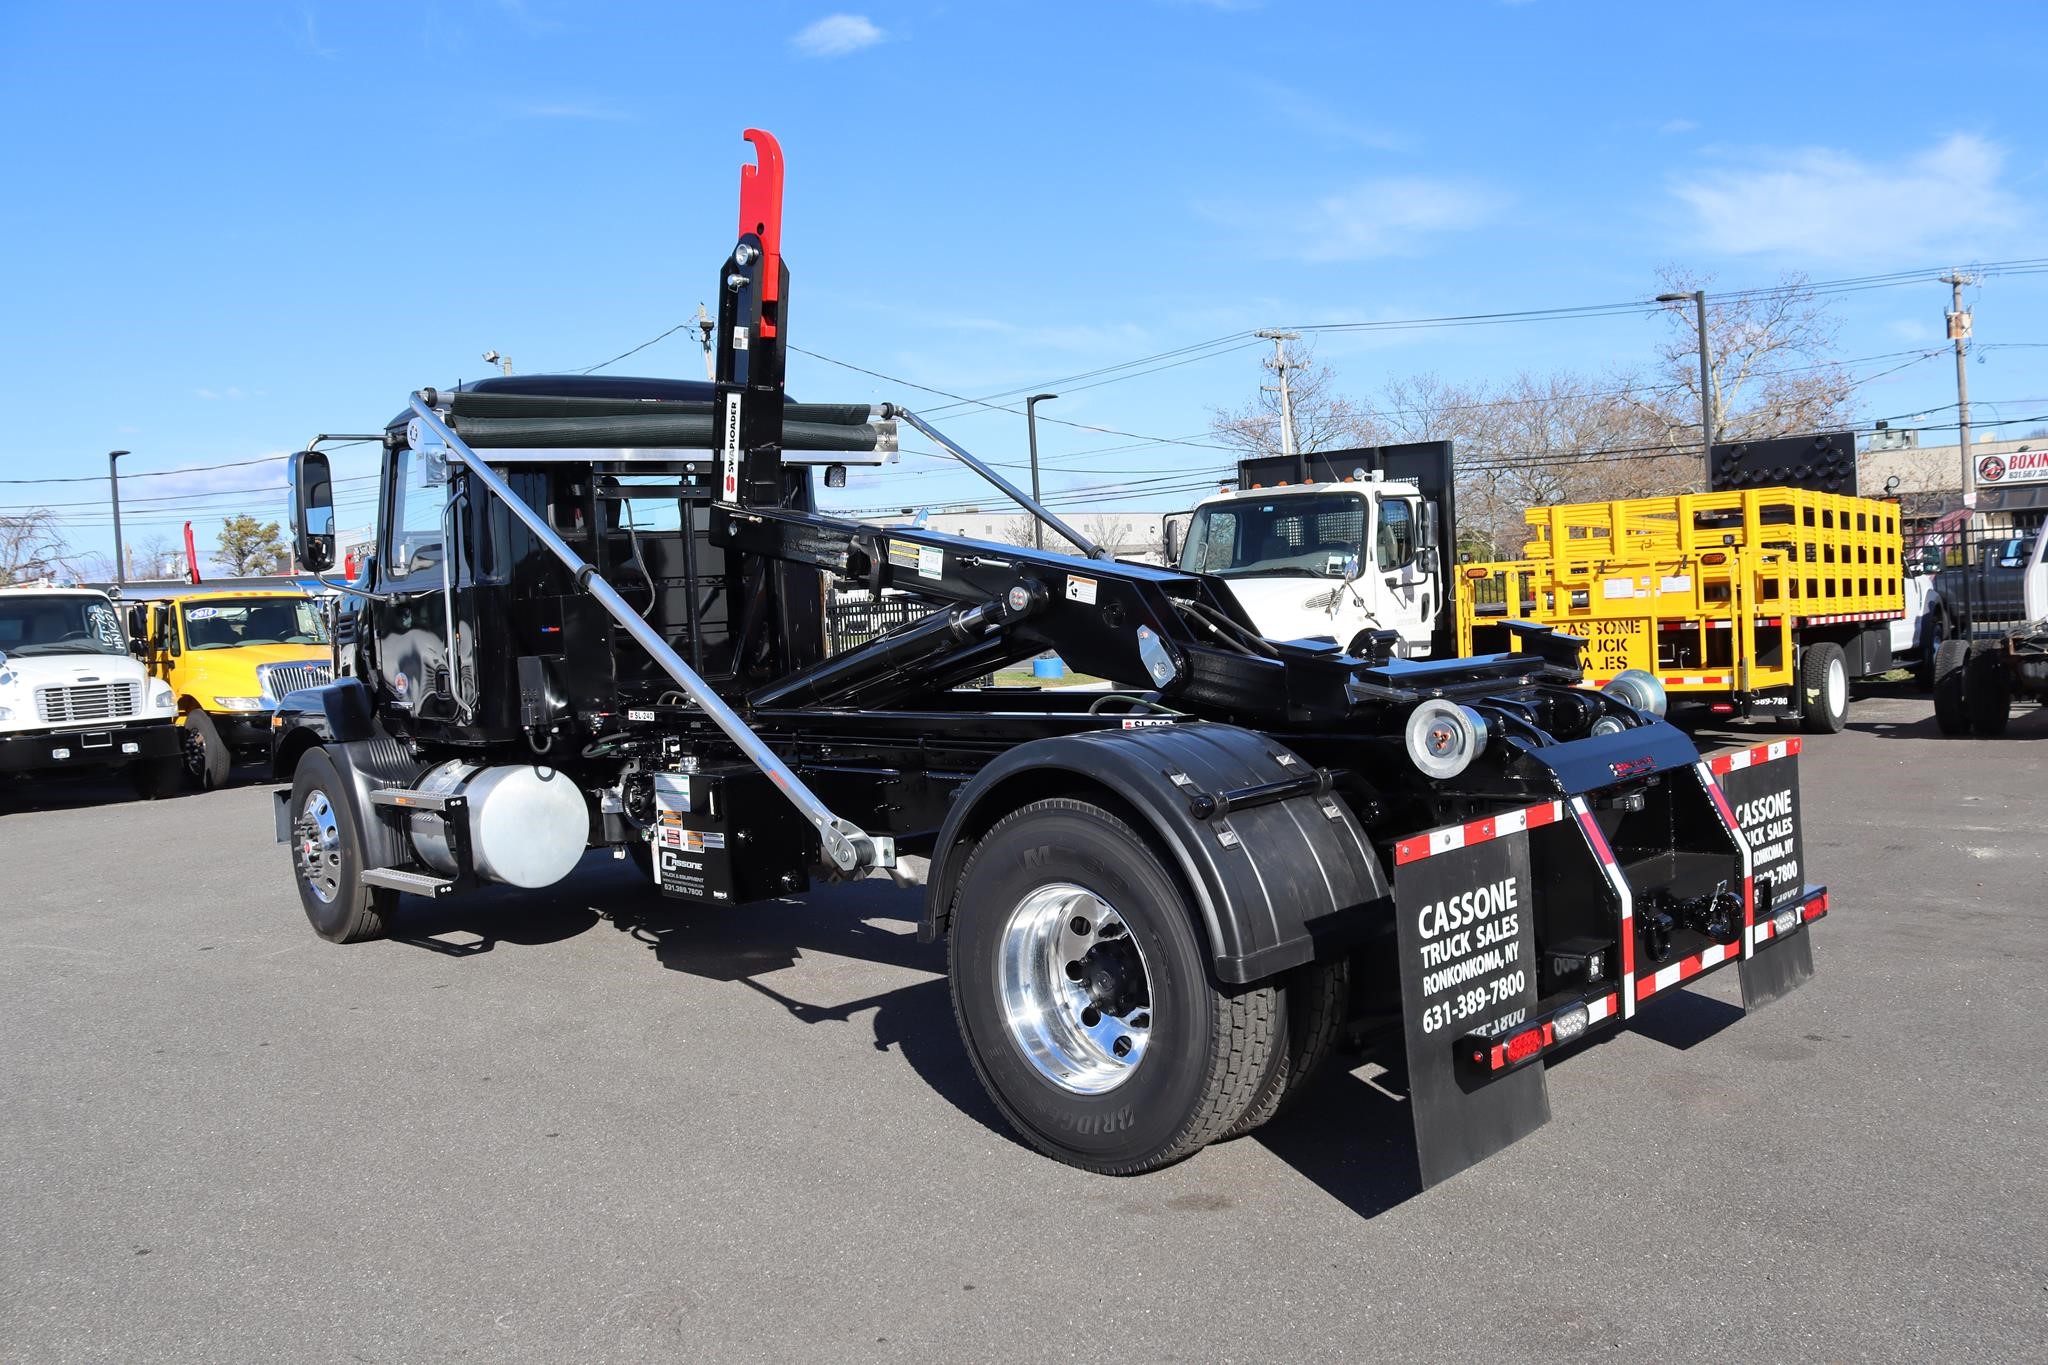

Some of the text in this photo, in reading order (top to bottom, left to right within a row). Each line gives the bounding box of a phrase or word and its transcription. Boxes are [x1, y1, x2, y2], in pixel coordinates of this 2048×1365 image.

[728, 401, 737, 473] SWAPLOADER
[1555, 620, 1640, 636] ASSONE
[1578, 638, 1628, 653] RUCK
[1767, 817, 1793, 841] SALES
[1785, 838, 1793, 855] NY
[661, 851, 703, 871] CASSONE
[1418, 877, 1518, 939] CASSONE
[1420, 913, 1519, 969] TRUCK SALES
[1423, 941, 1519, 997] RONKONKOMA, NY
[1422, 970, 1525, 1034] 631-389-7800
